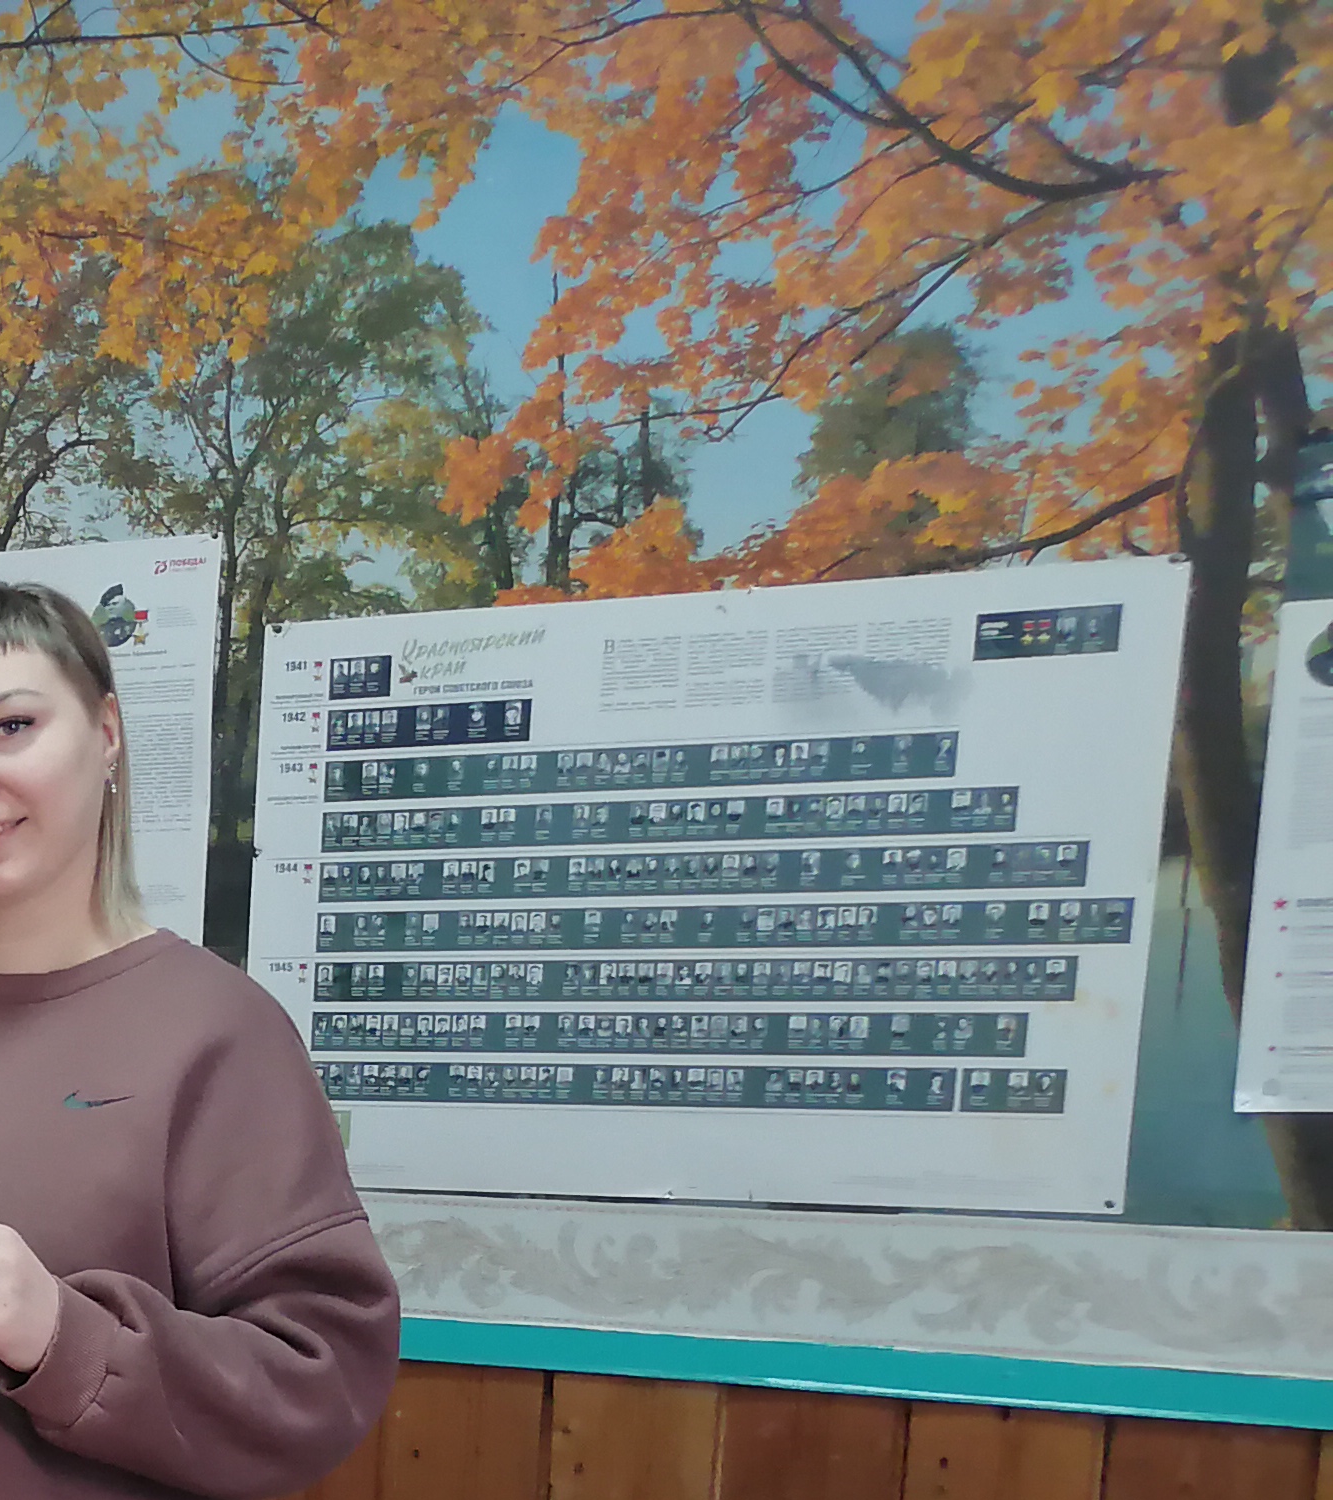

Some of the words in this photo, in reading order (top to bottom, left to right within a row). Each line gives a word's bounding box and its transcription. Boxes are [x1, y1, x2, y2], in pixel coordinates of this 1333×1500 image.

[285, 661, 308, 672] 1941
[282, 711, 306, 723] 1942
[279, 763, 304, 774] 1943
[275, 863, 298, 873] 1944
